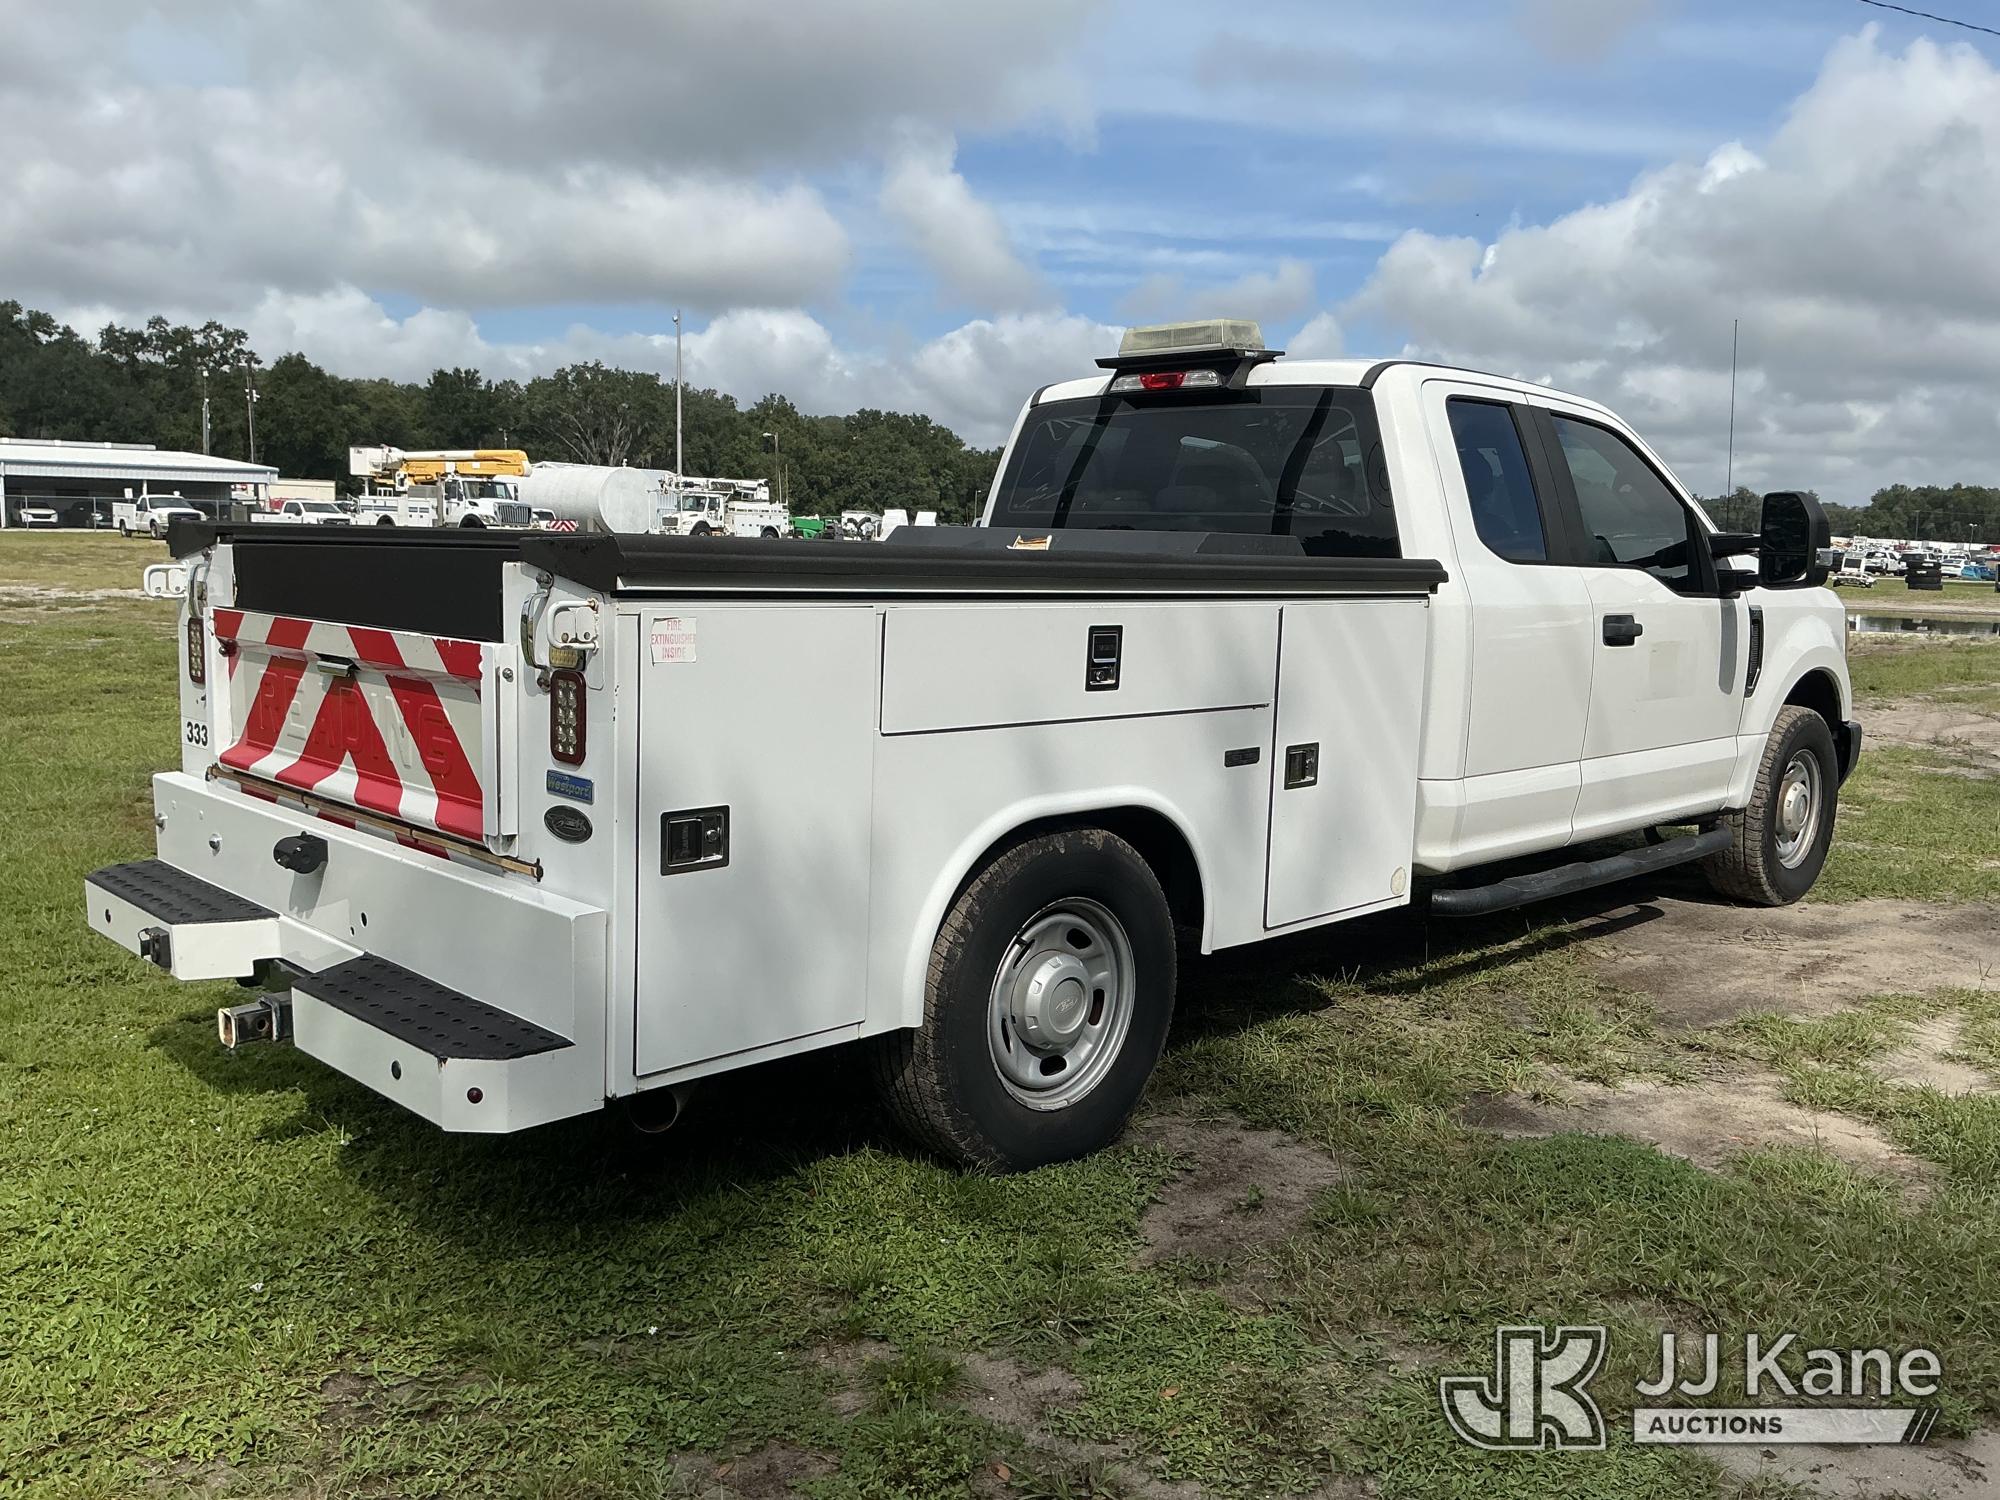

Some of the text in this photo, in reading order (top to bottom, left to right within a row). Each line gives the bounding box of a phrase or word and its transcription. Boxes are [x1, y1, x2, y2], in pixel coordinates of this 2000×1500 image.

[666, 619, 683, 631] FIRE
[662, 646, 687, 659] INSIDE
[186, 720, 208, 747] 333
[257, 669, 453, 778] READING
